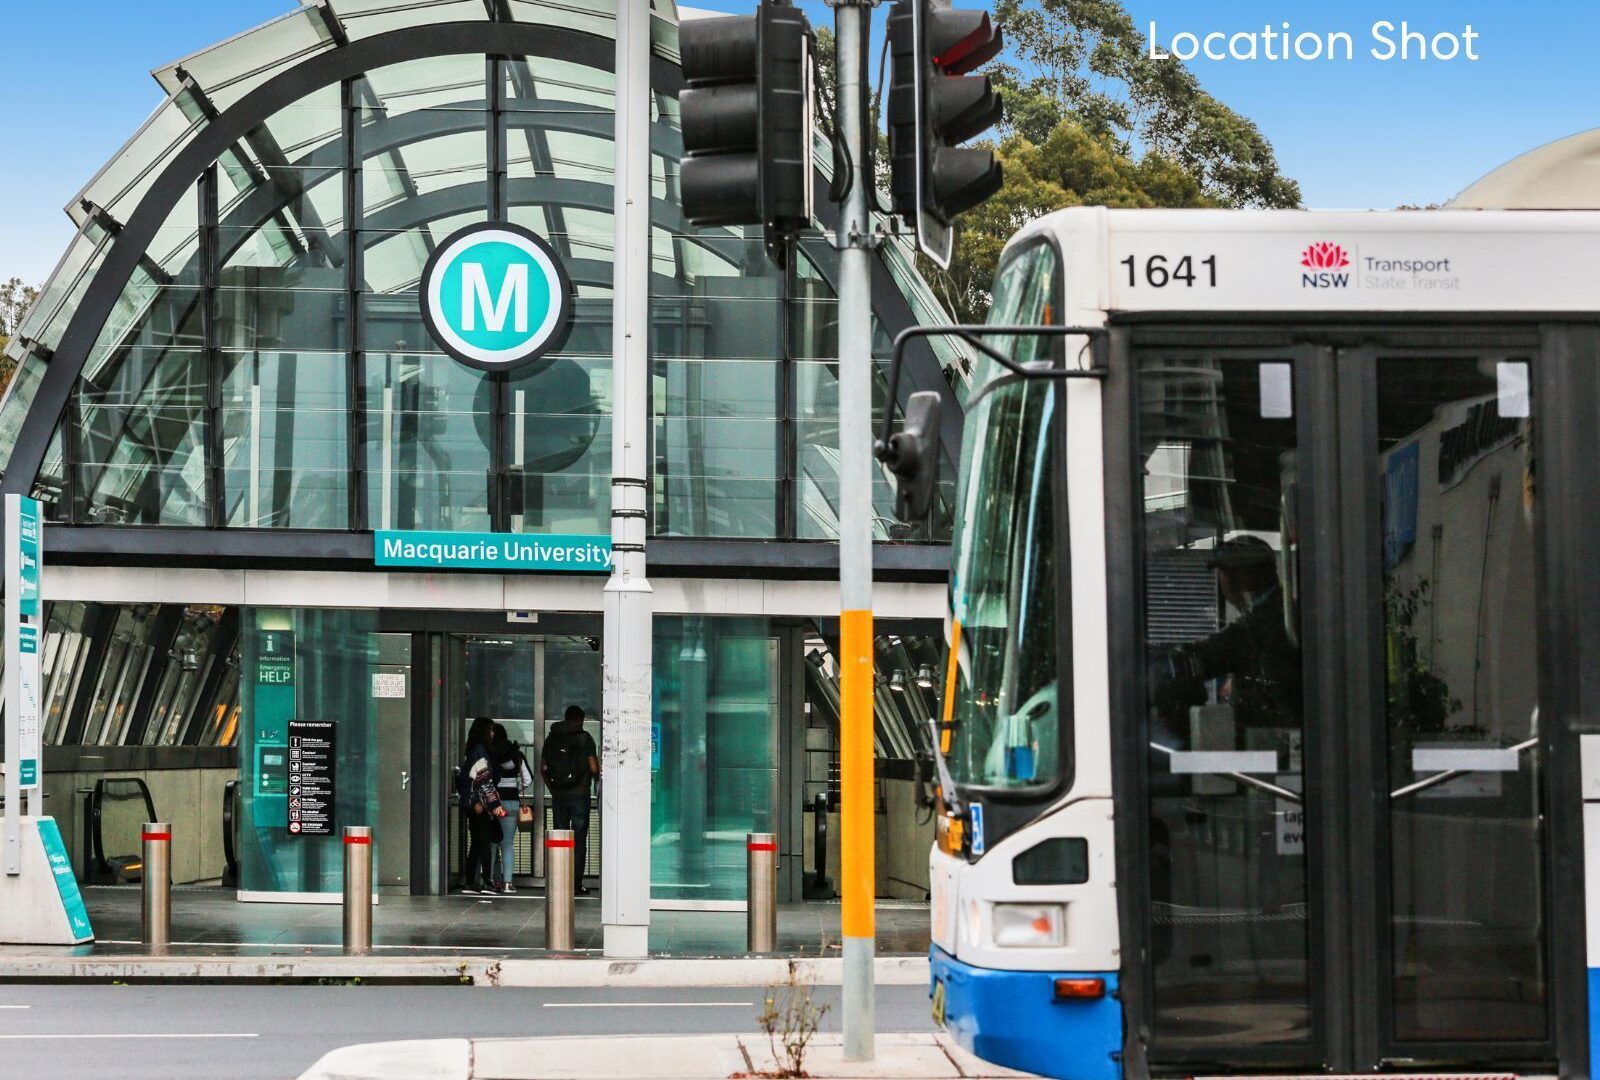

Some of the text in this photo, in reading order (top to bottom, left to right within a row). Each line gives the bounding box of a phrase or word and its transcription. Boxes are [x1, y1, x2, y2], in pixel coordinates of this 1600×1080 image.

[1120, 254, 1216, 288] 1641
[1364, 256, 1450, 275] Transport
[1302, 273, 1349, 288] NSW
[1365, 275, 1461, 290] State Transit
[461, 262, 528, 332] M
[383, 538, 612, 568] Macquarie University
[260, 664, 290, 672] Emergency
[259, 671, 290, 683] HELP
